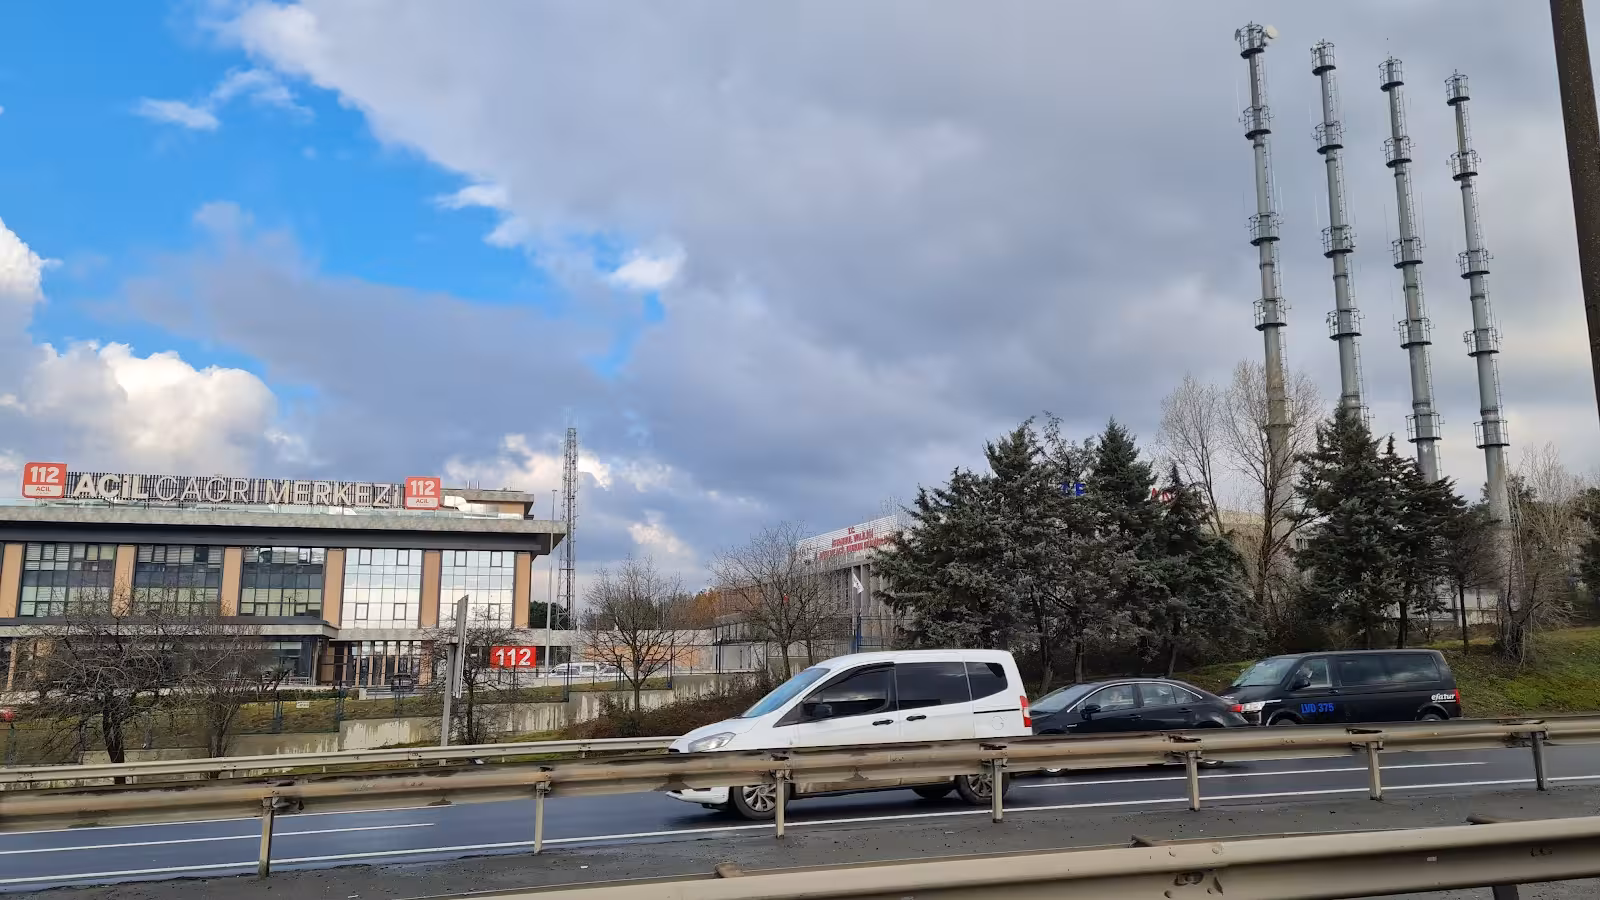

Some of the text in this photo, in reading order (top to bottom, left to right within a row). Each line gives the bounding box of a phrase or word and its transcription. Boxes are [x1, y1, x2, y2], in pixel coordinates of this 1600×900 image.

[30, 465, 60, 483] 112
[155, 474, 259, 506] ÇAĞRI
[265, 479, 400, 508] MERKEZİ
[410, 480, 435, 496] 112
[495, 648, 531, 666] 112
[1431, 693, 1456, 701] efatur
[1317, 702, 1335, 713] 375
